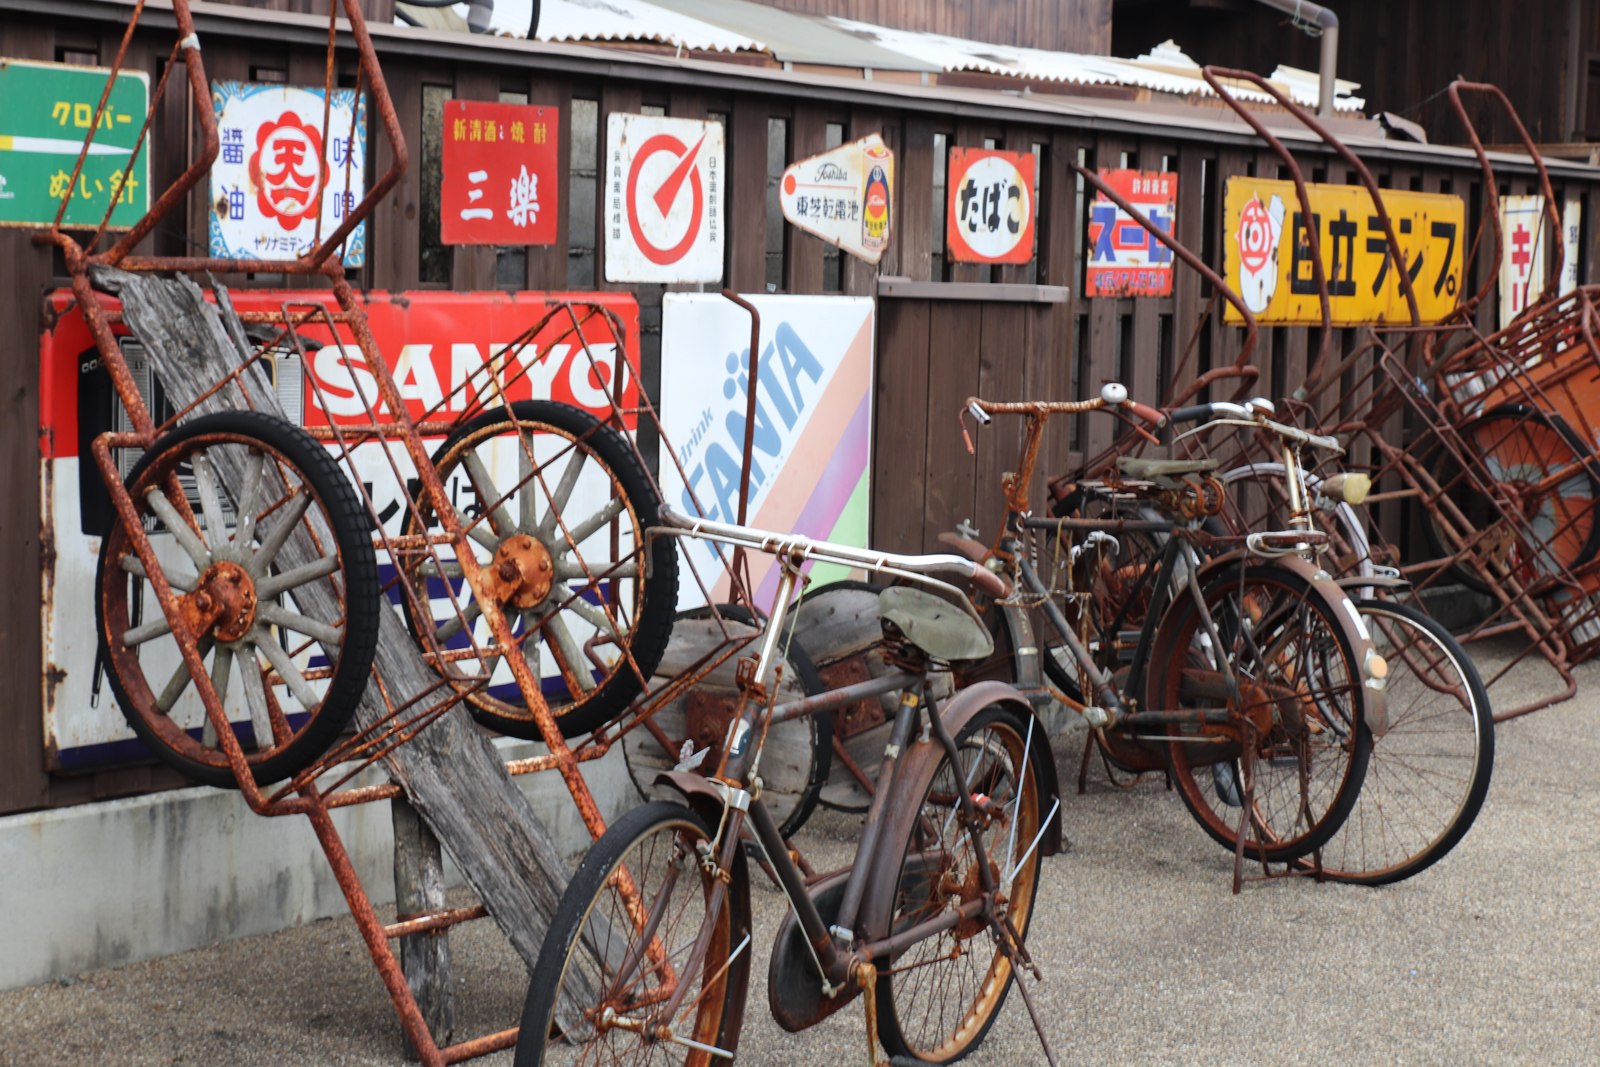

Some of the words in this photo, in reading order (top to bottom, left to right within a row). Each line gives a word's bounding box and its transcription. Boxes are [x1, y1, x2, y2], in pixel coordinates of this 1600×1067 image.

[52, 102, 132, 130] クロバー
[50, 169, 139, 204] ぬい針
[815, 163, 848, 183] Toshiba
[797, 196, 859, 222] 東芝乾電池
[961, 178, 1020, 233] たばこ
[312, 343, 630, 417] SANYO
[679, 407, 714, 468] drink
[681, 321, 824, 561] FANTA
